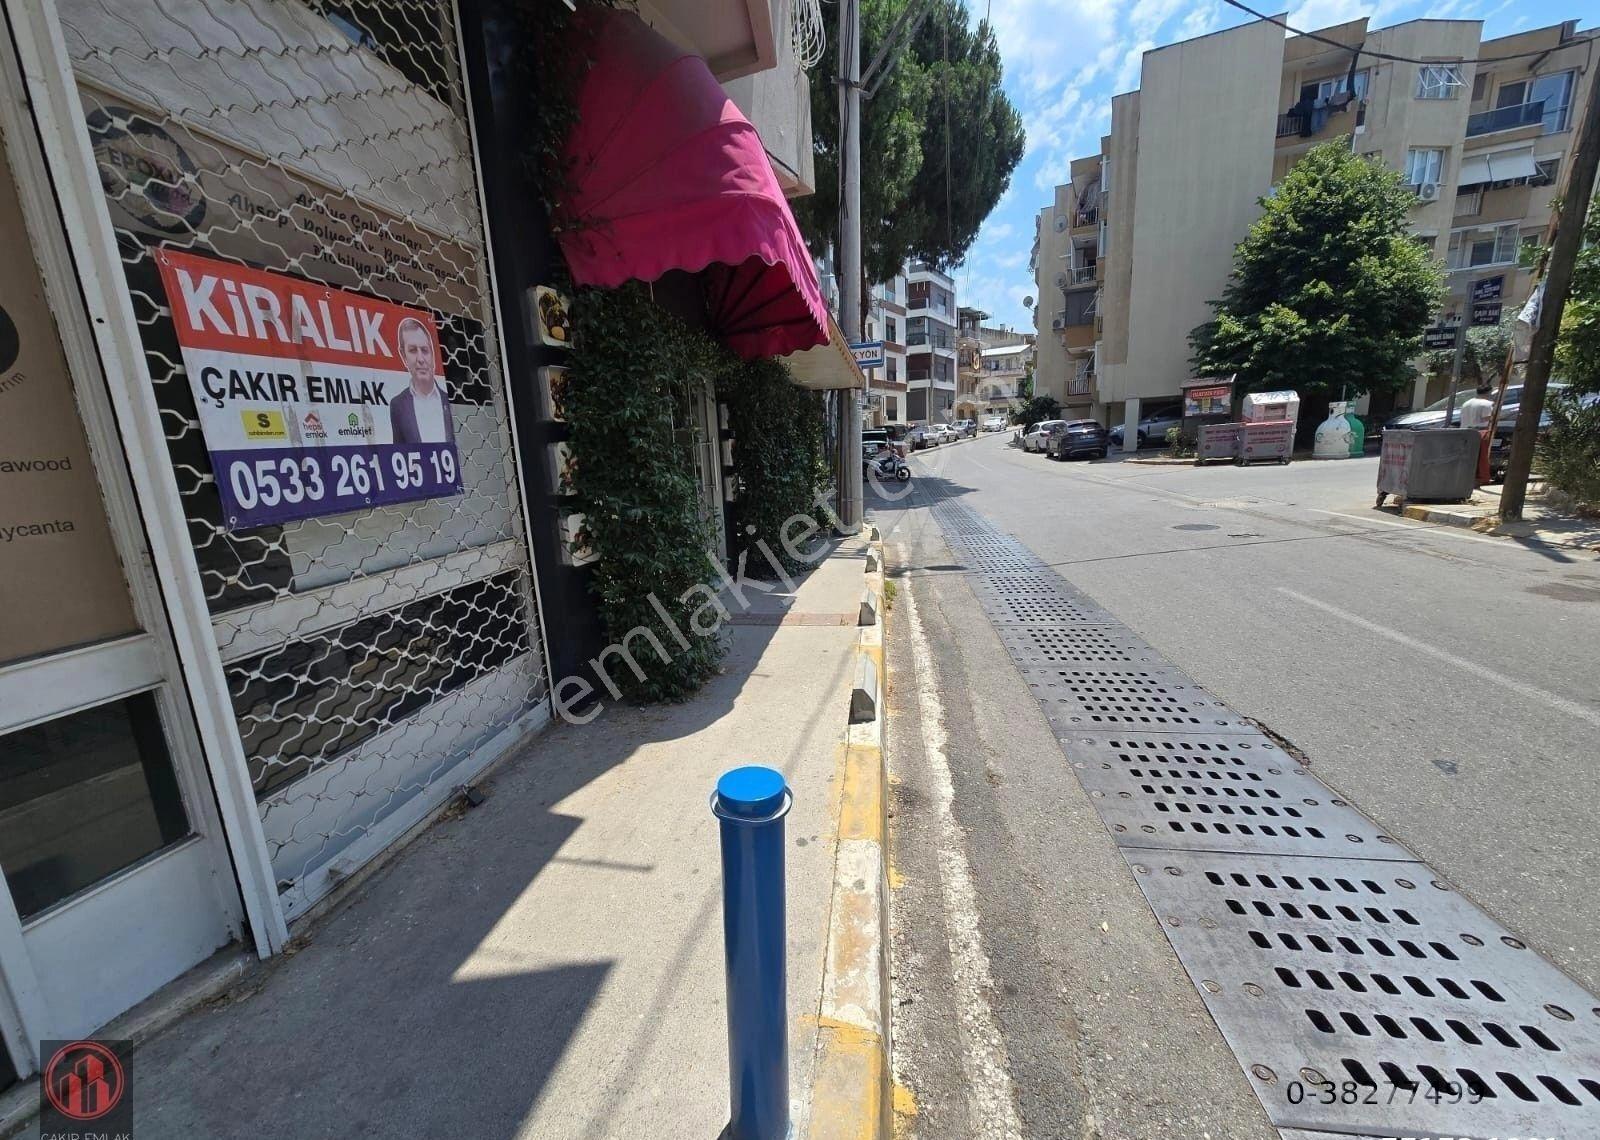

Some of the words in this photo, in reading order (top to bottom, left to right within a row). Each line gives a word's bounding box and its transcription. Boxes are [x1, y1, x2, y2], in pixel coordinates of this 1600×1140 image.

[201, 367, 299, 409] ÇAKIR
[306, 376, 389, 406] EMLAK
[305, 431, 328, 439] emlak
[338, 426, 373, 438] emlakjet
[229, 456, 325, 510] 0533
[331, 453, 385, 497] 261
[391, 451, 423, 491] 95
[430, 449, 456, 484] 19
